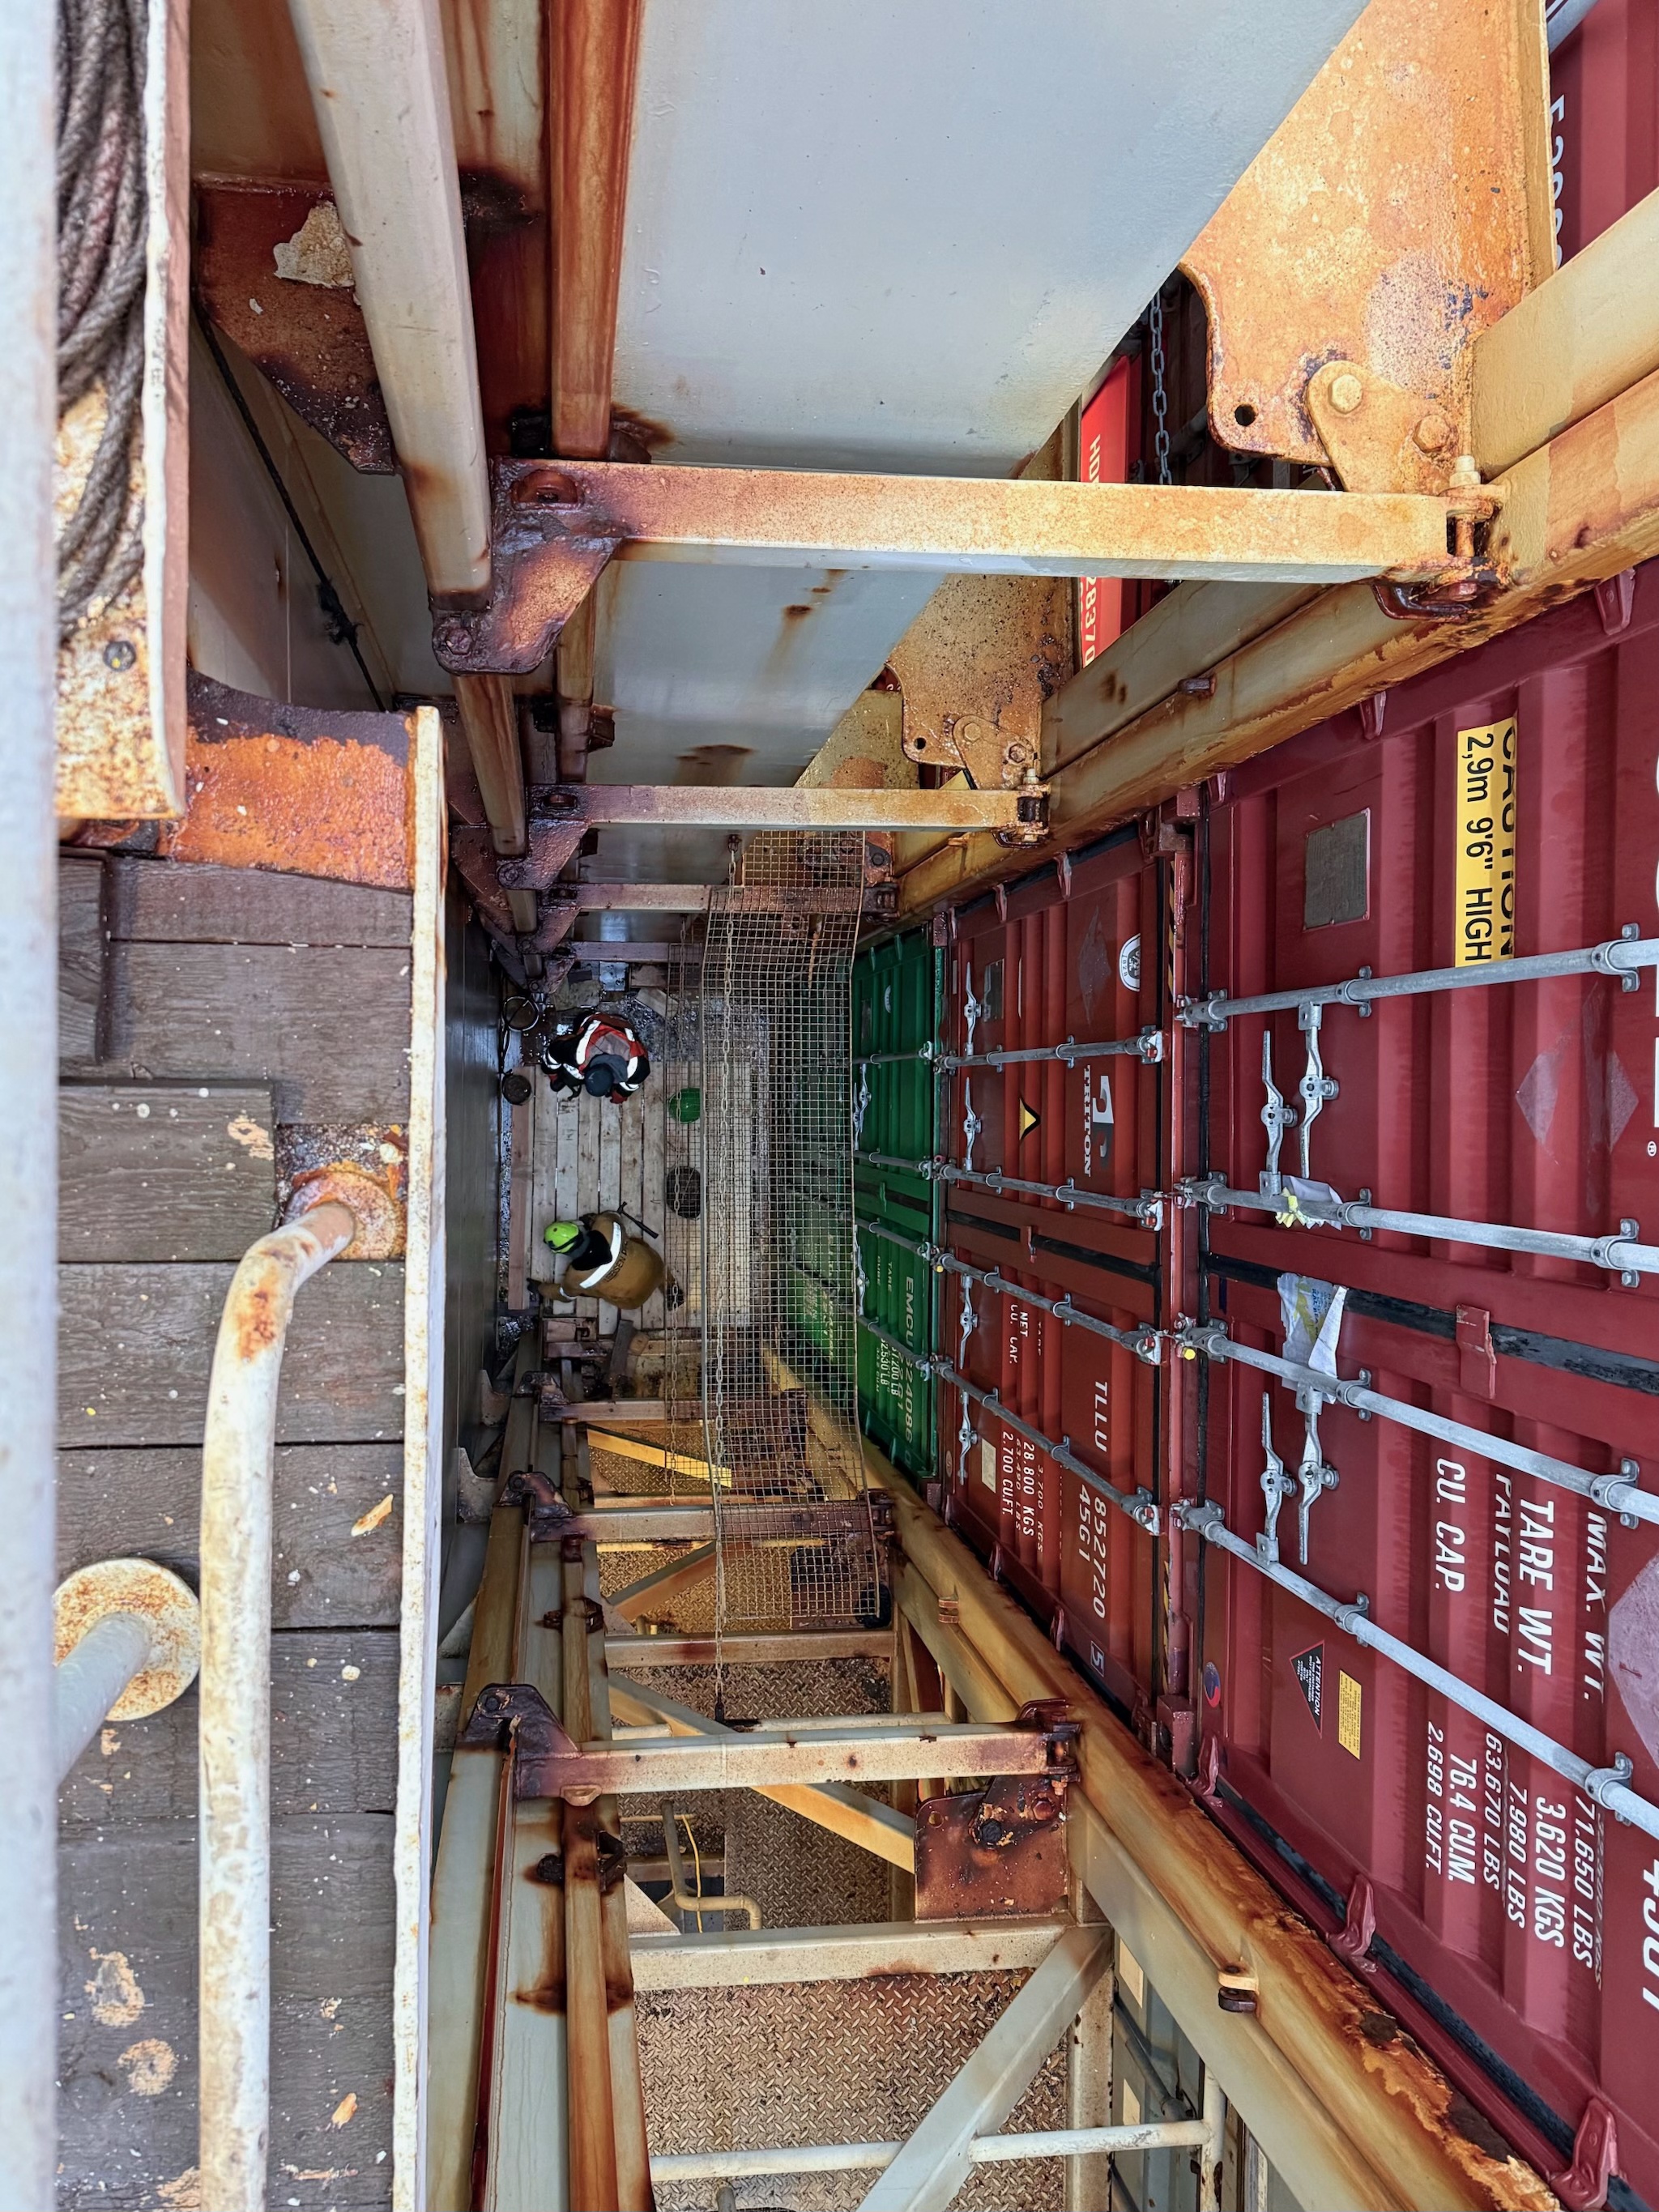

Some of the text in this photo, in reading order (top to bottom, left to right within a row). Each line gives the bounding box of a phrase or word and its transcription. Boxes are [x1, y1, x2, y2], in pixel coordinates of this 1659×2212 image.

[1462, 733, 1495, 803] 2,9m
[1465, 887, 1493, 961] HIGH
[906, 1276, 915, 1348] EMCU
[1020, 1311, 1029, 1337] NET
[1094, 1379, 1108, 1453] TLLU
[1022, 1505, 1035, 1537] KGS
[1077, 1483, 1091, 1563] 45G1
[1492, 1473, 1512, 1635] PAYLOAD
[1518, 1498, 1555, 1591] TARE
[1092, 1495, 1107, 1620] 852720
[1435, 1457, 1477, 1886] CU. CAP. 76.4 CU.M.
[1516, 1608, 1553, 1676] WT.
[1314, 1656, 1322, 1716] ATTENTION
[1425, 1802, 1444, 1876] CU.FT.
[1482, 1832, 1501, 1892] LBS
[1507, 1868, 1527, 1929] LBS
[1533, 1884, 1566, 1950] KGS
[1572, 1903, 1594, 1970] LBS
